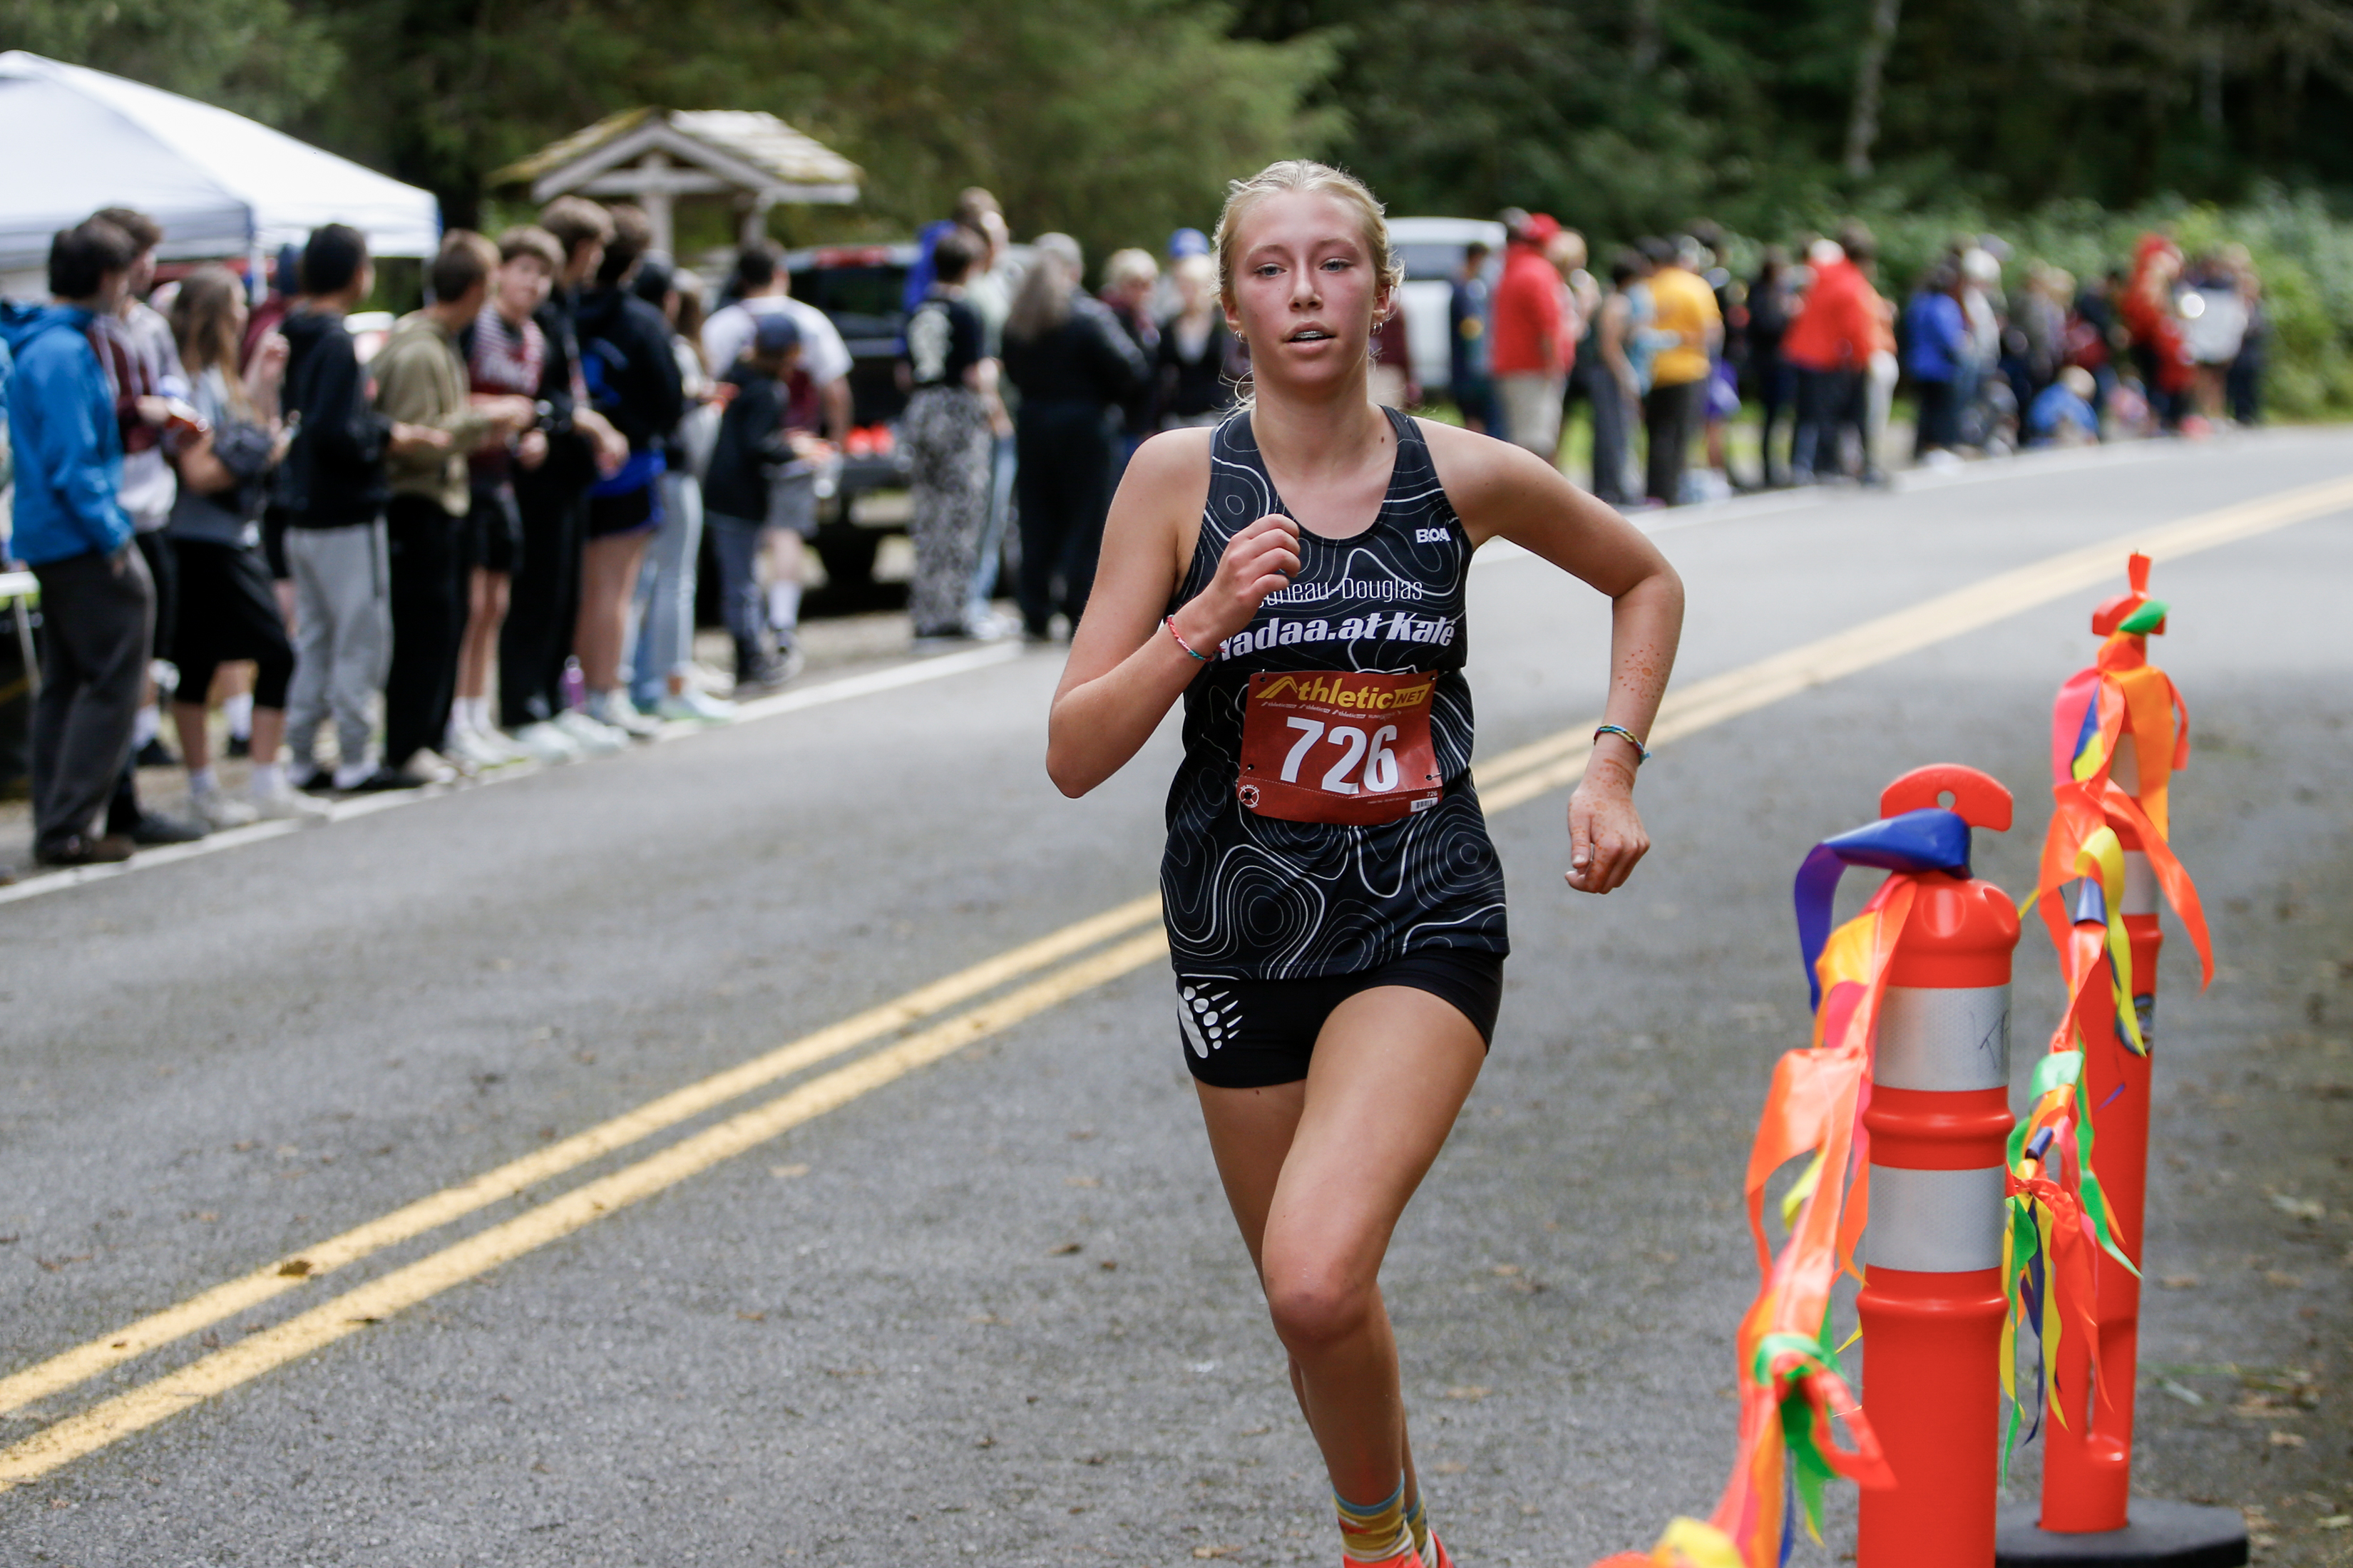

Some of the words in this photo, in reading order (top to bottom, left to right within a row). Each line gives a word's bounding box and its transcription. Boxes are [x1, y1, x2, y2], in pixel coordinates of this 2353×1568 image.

[1259, 578, 1422, 608] uneau-Douglas
[1385, 612, 1455, 647] Kalé
[1280, 716, 1399, 795] 726
